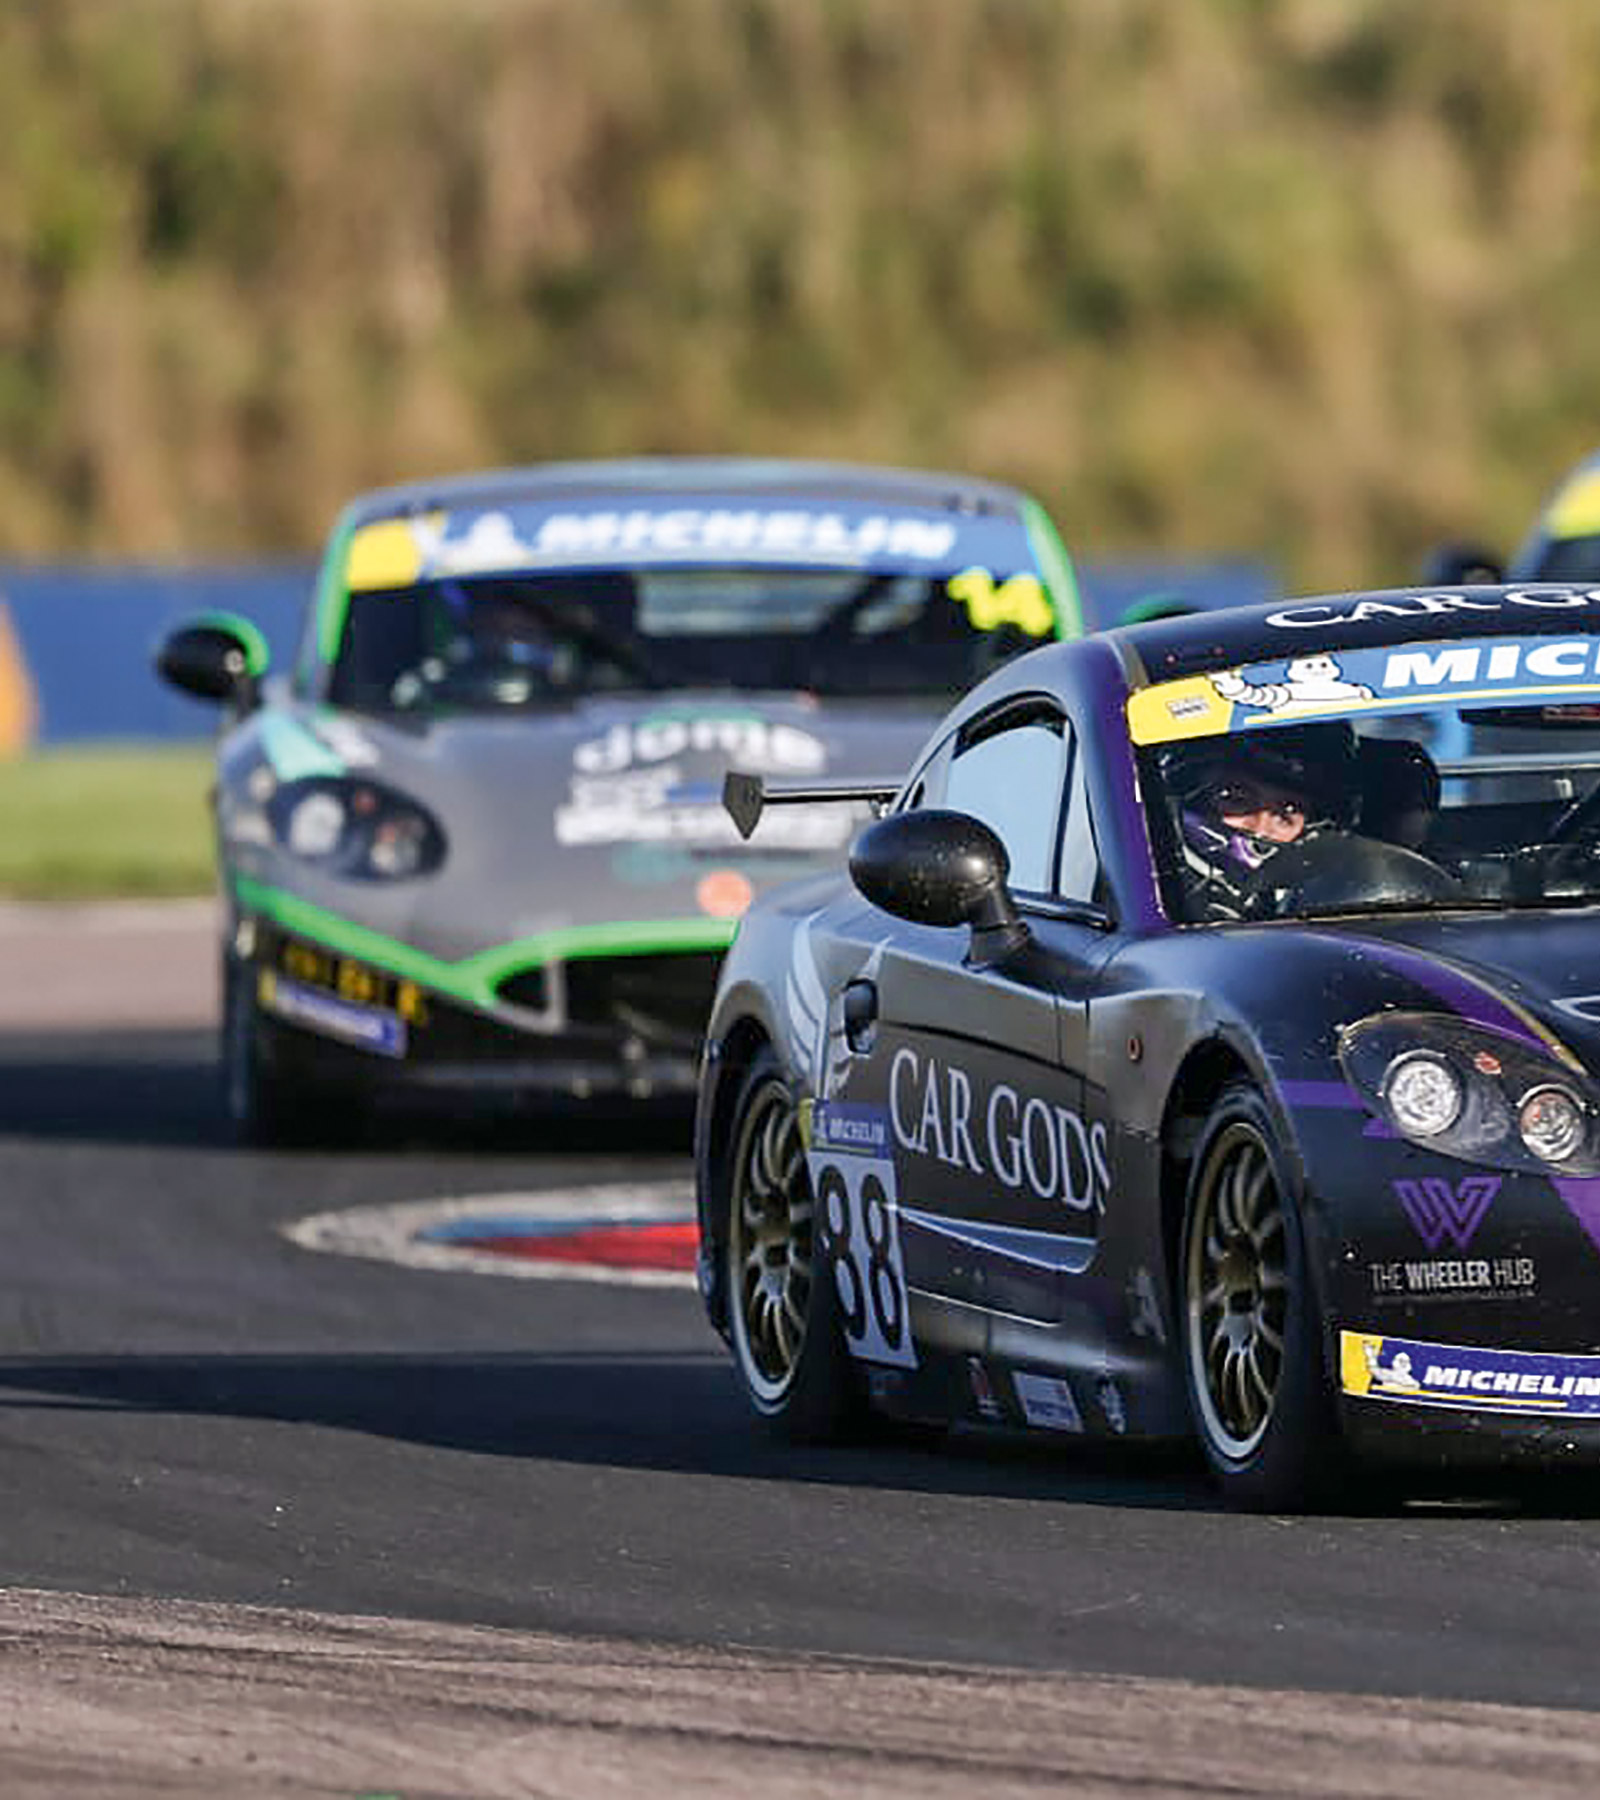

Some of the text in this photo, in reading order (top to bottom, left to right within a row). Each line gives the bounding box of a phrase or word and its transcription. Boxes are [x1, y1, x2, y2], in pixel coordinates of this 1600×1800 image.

[534, 508, 957, 561] MICHELIN
[948, 565, 1054, 637] 14
[1264, 593, 1500, 628] CAR
[829, 1114, 885, 1146] MICHELIN
[889, 1047, 1110, 1217] CAR GODS
[817, 1164, 902, 1352] 88
[1368, 1258, 1535, 1292] THE WHEELER HUB
